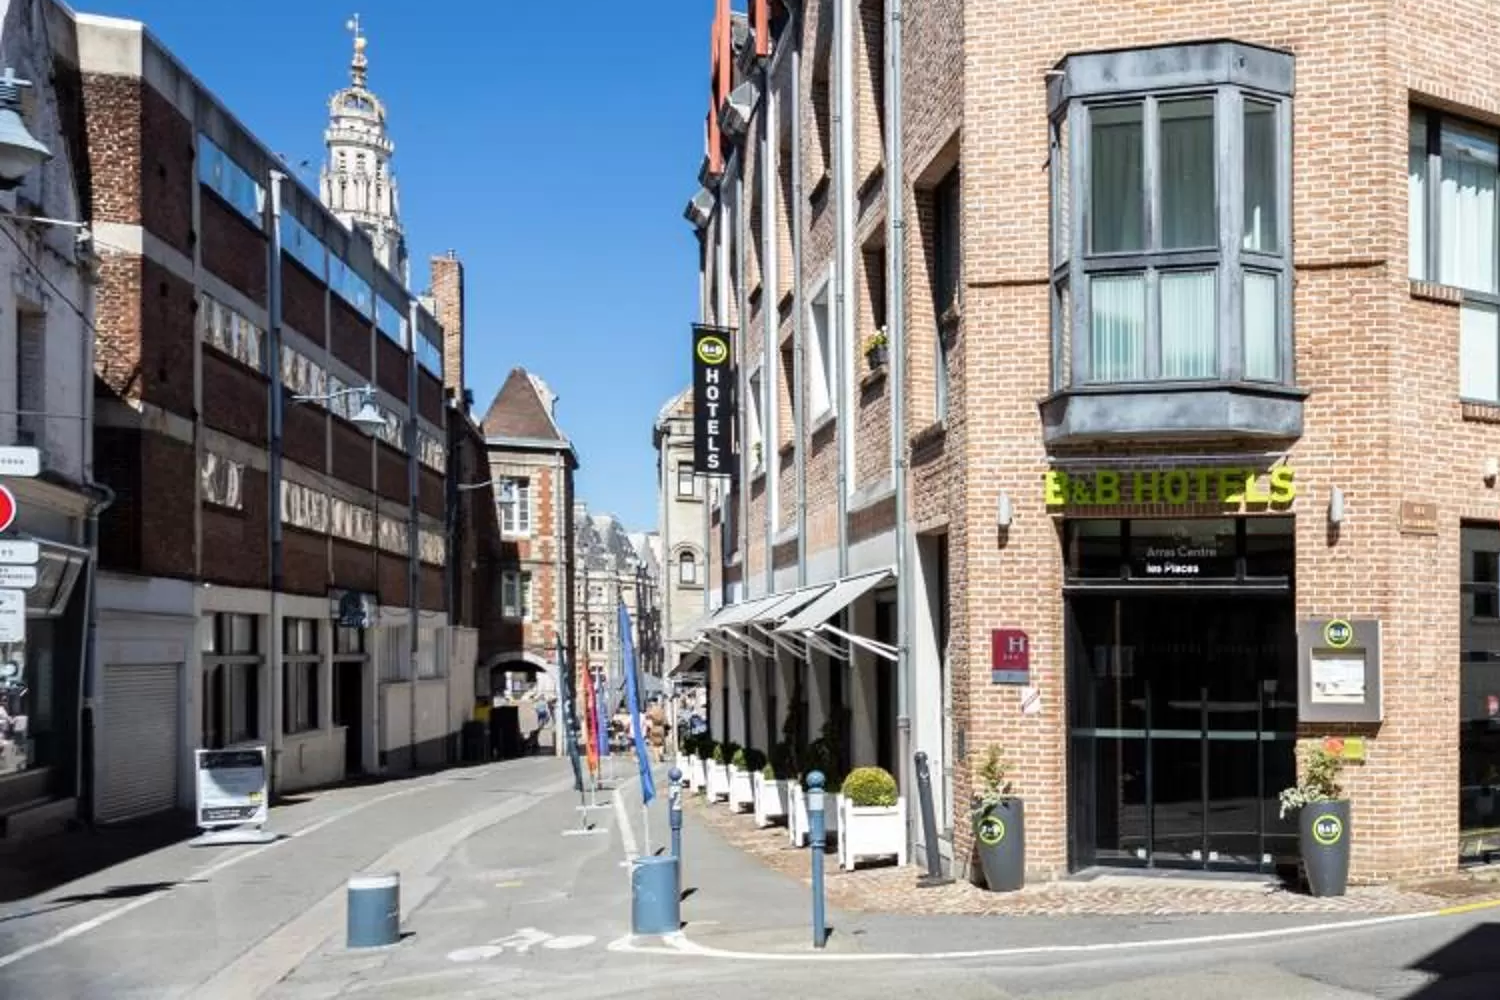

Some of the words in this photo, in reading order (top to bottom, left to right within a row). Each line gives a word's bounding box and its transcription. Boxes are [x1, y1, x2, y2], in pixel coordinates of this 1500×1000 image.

[705, 367, 719, 469] HOTELS
[1044, 470, 1120, 505] B&B
[1133, 467, 1297, 506] HOTELS
[1009, 636, 1025, 652] H
